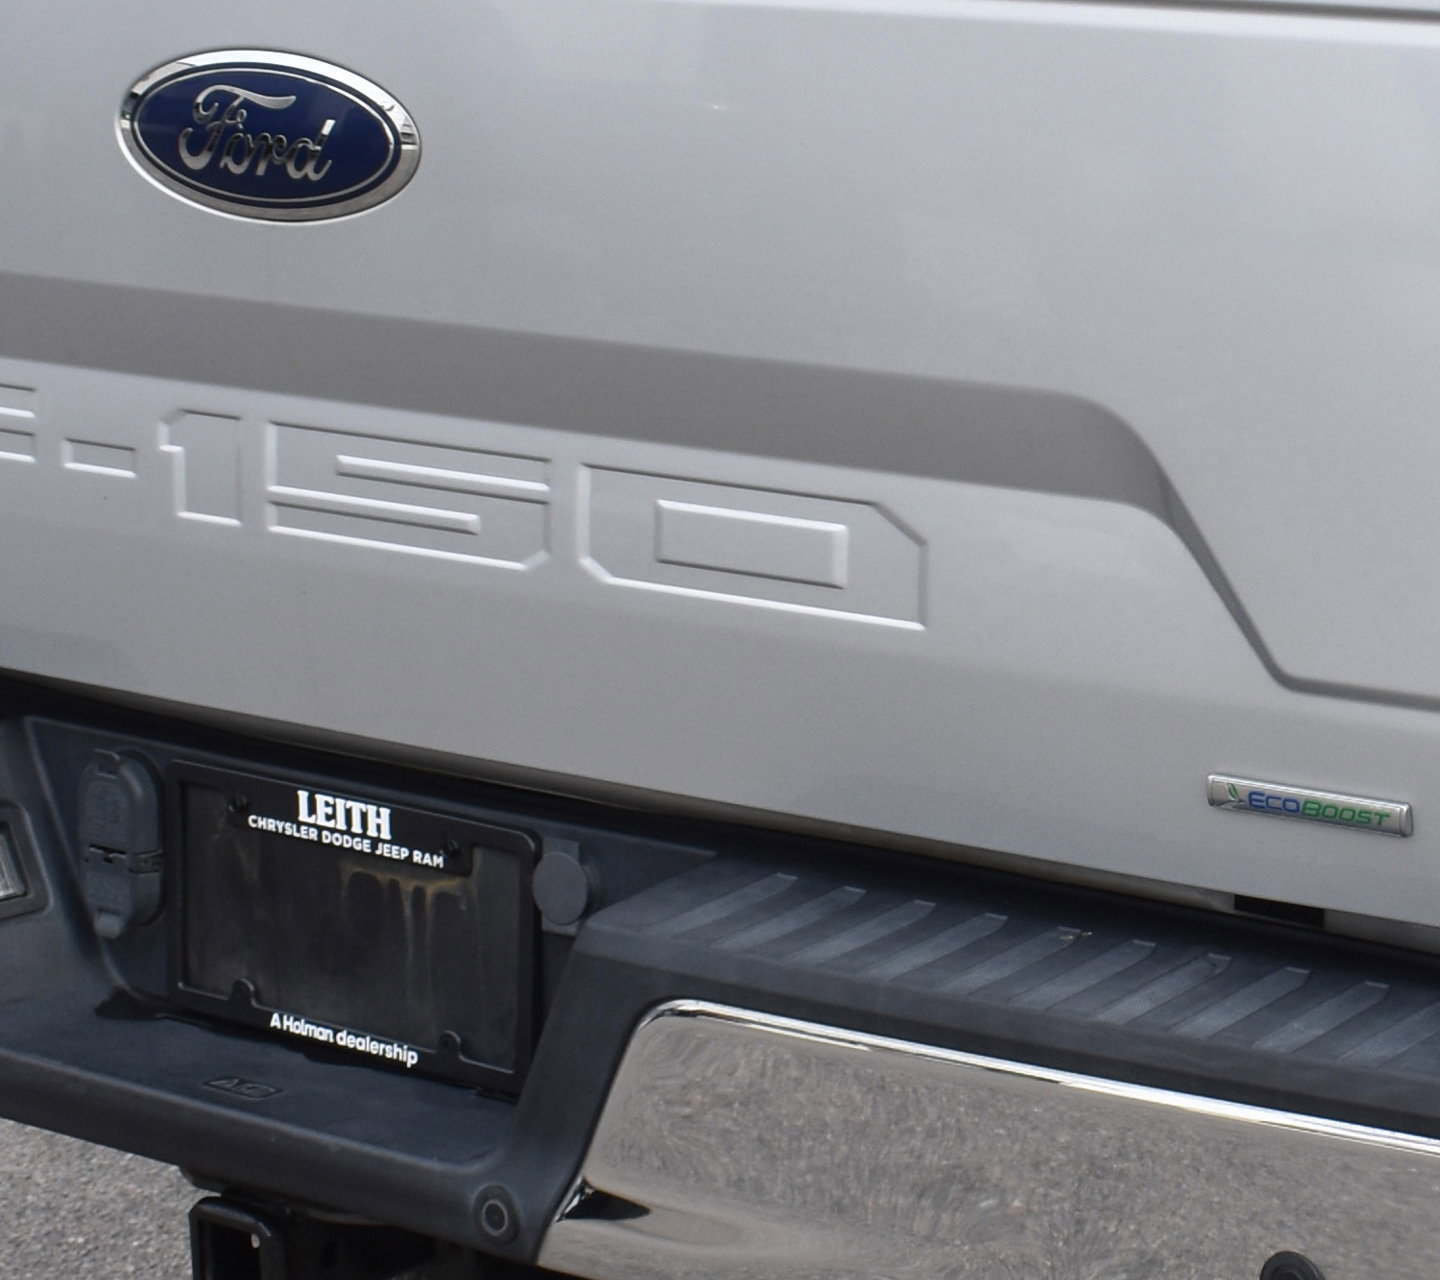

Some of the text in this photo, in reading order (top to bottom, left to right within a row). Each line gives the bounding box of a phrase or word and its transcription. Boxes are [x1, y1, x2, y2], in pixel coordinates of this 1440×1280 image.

[178, 84, 336, 182] Ford
[247, 814, 445, 870] CHRYSLER DODGE JEEP RAM
[296, 789, 392, 841] LEITH
[269, 1012, 419, 1069] A Holman dealership
